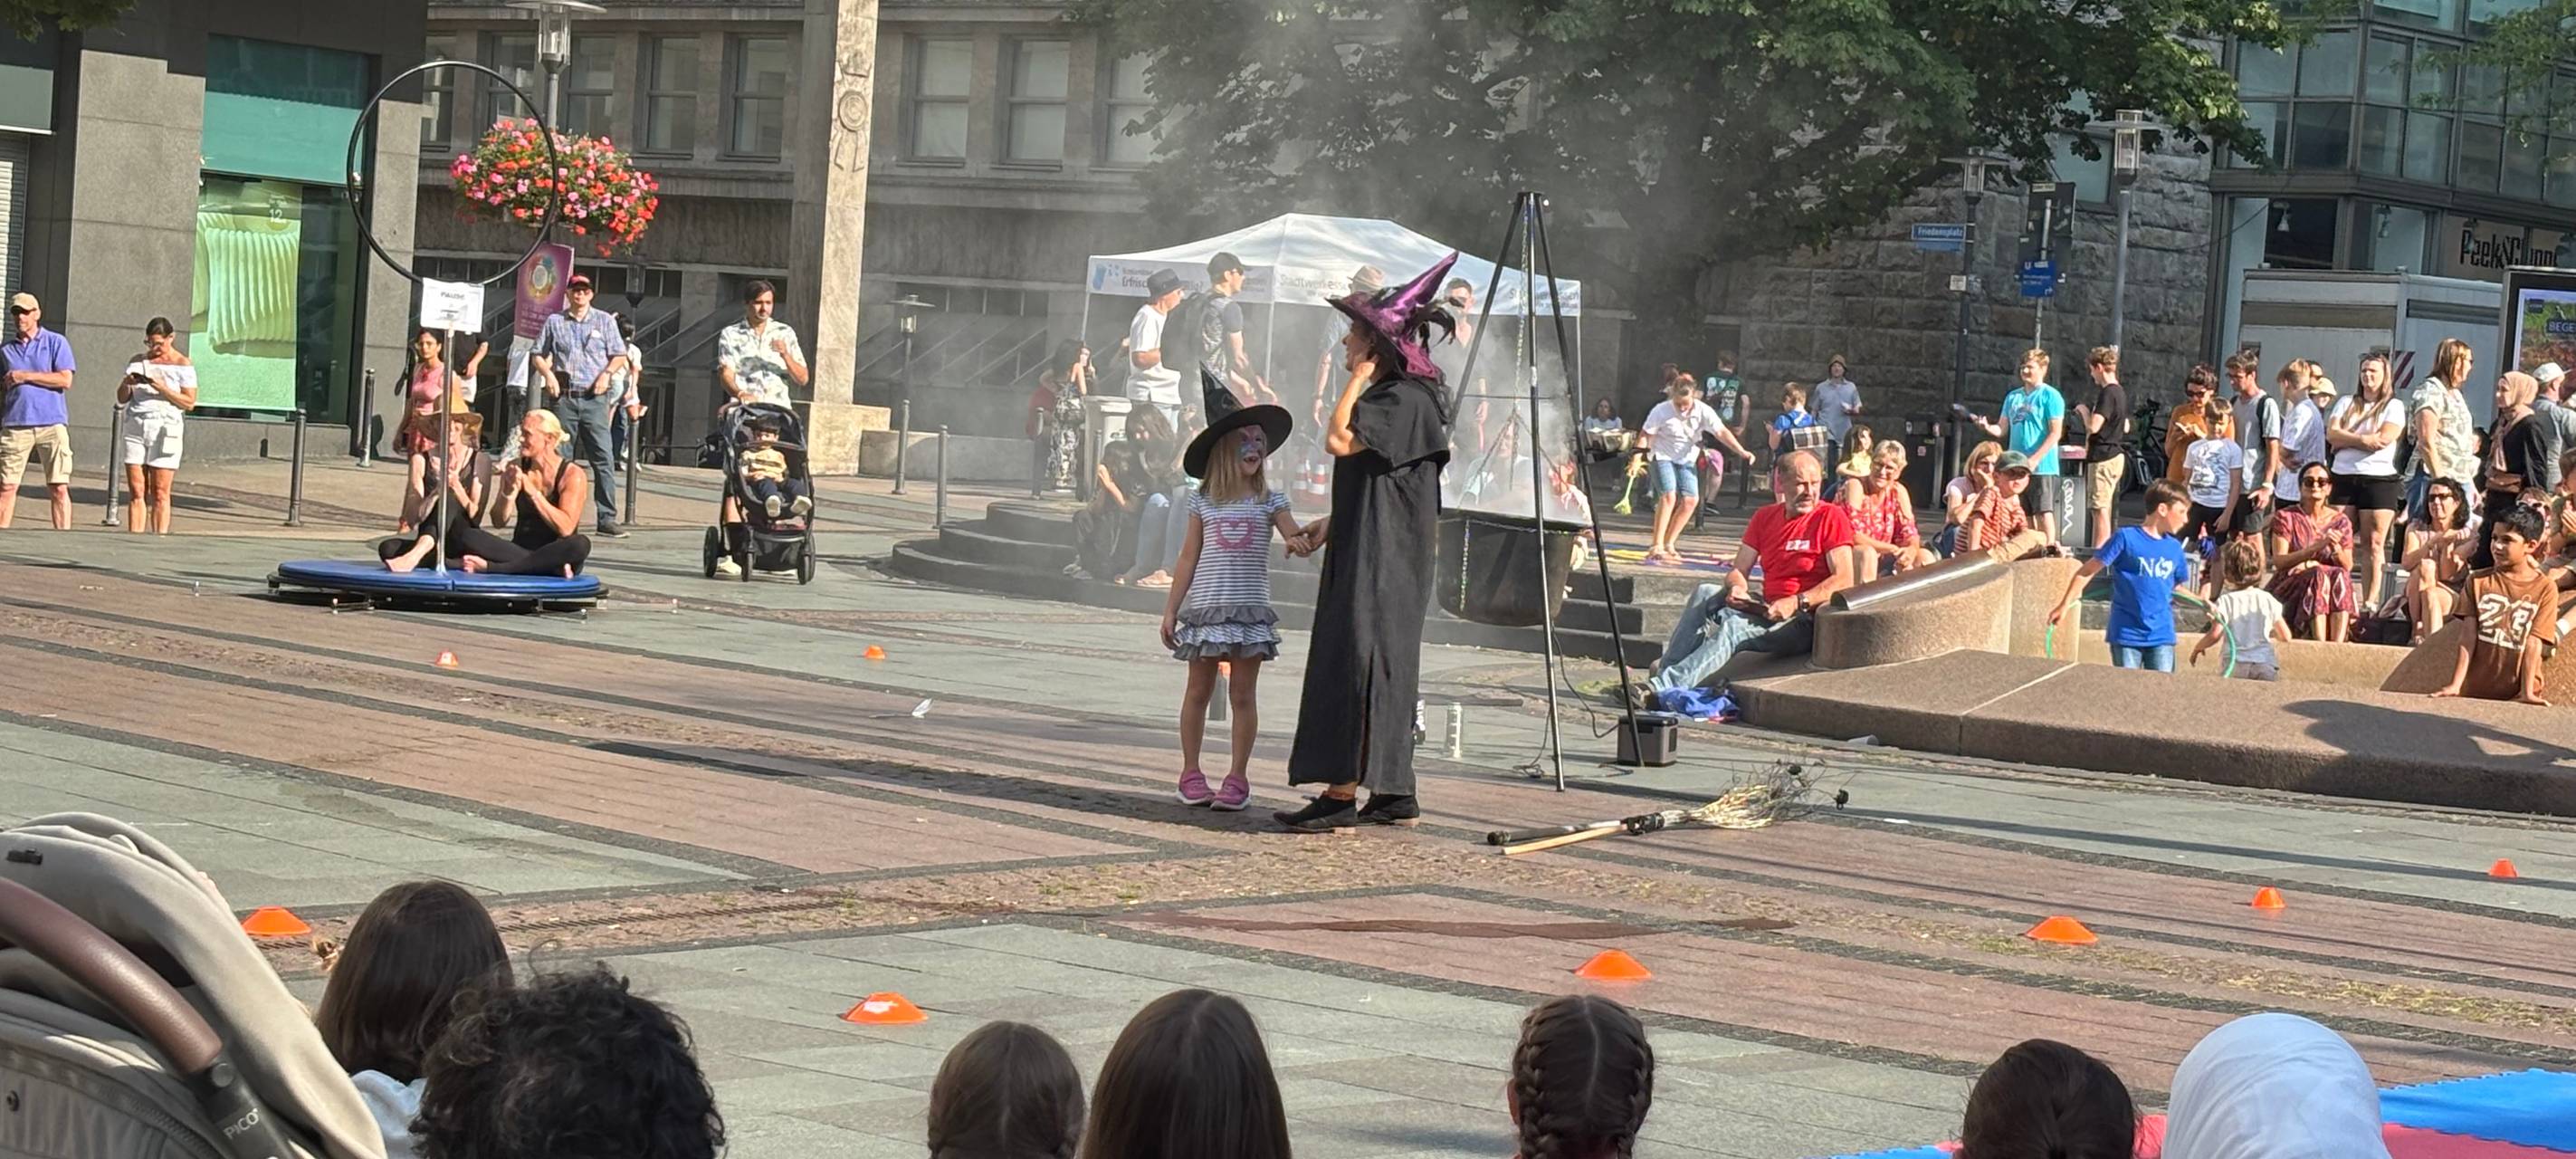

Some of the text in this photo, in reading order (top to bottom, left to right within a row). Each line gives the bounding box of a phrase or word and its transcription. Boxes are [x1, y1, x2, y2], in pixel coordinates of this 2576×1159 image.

[1918, 226, 1963, 238] Friedensplatz
[2024, 262, 2031, 270] U
[1122, 276, 1149, 288] Erfrisc
[1280, 273, 1350, 291] Stadtwerkess
